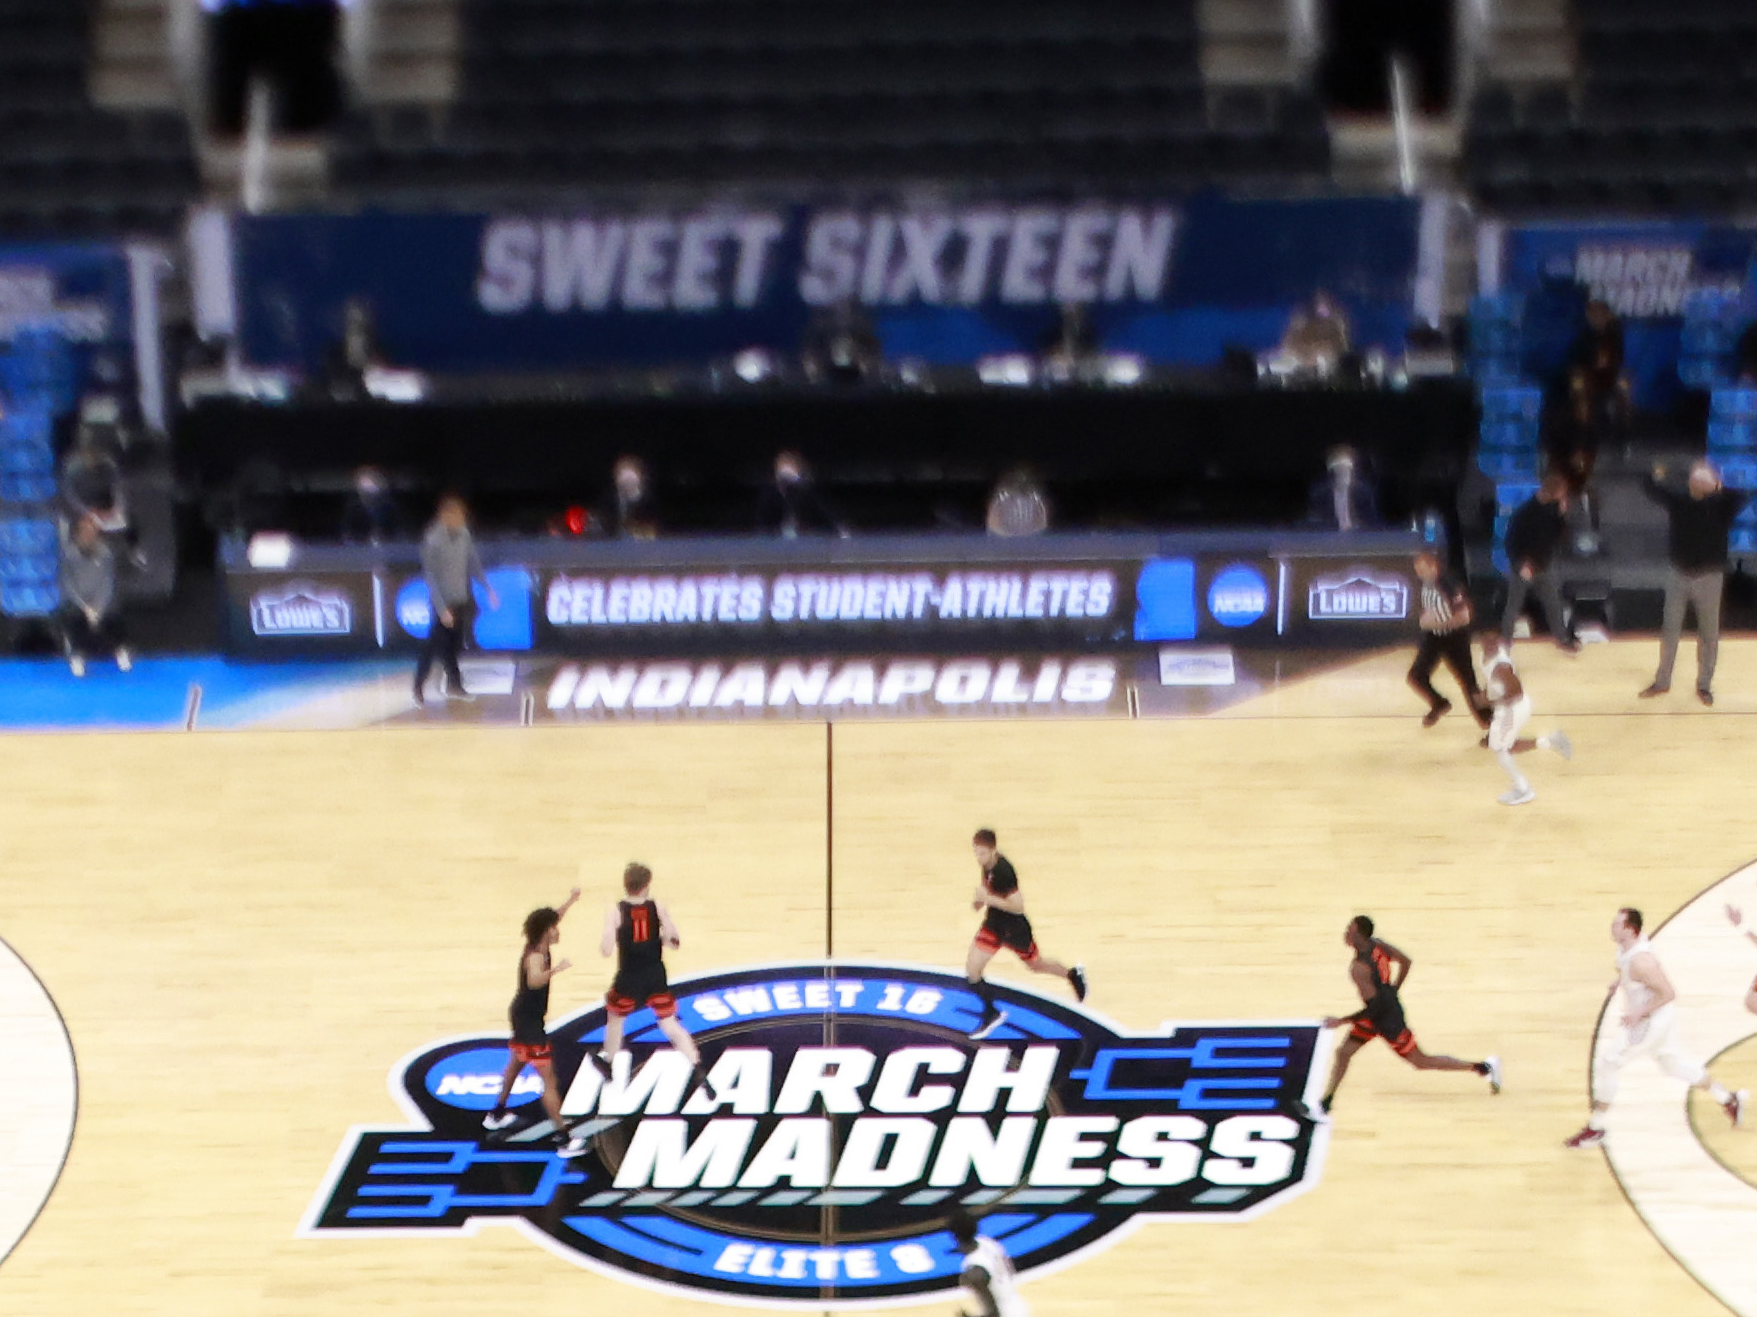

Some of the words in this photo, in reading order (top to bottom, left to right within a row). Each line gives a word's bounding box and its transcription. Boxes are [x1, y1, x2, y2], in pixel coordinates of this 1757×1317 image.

[477, 220, 781, 314] SWEET
[799, 212, 1175, 305] SIXTEEN
[546, 575, 764, 625] CELEBRATES
[770, 574, 1112, 620] STUDENT-ATHLETES
[1214, 590, 1264, 614] NCAA
[546, 661, 1117, 708] INDIANAPOLIS
[629, 905, 651, 944] 11
[692, 980, 865, 1022] SWEET
[877, 983, 943, 1015] 16
[559, 1046, 1060, 1116] MARCH
[612, 1115, 1299, 1188] MADNESS
[713, 1242, 880, 1281] ELITE
[890, 1243, 935, 1274] 8
